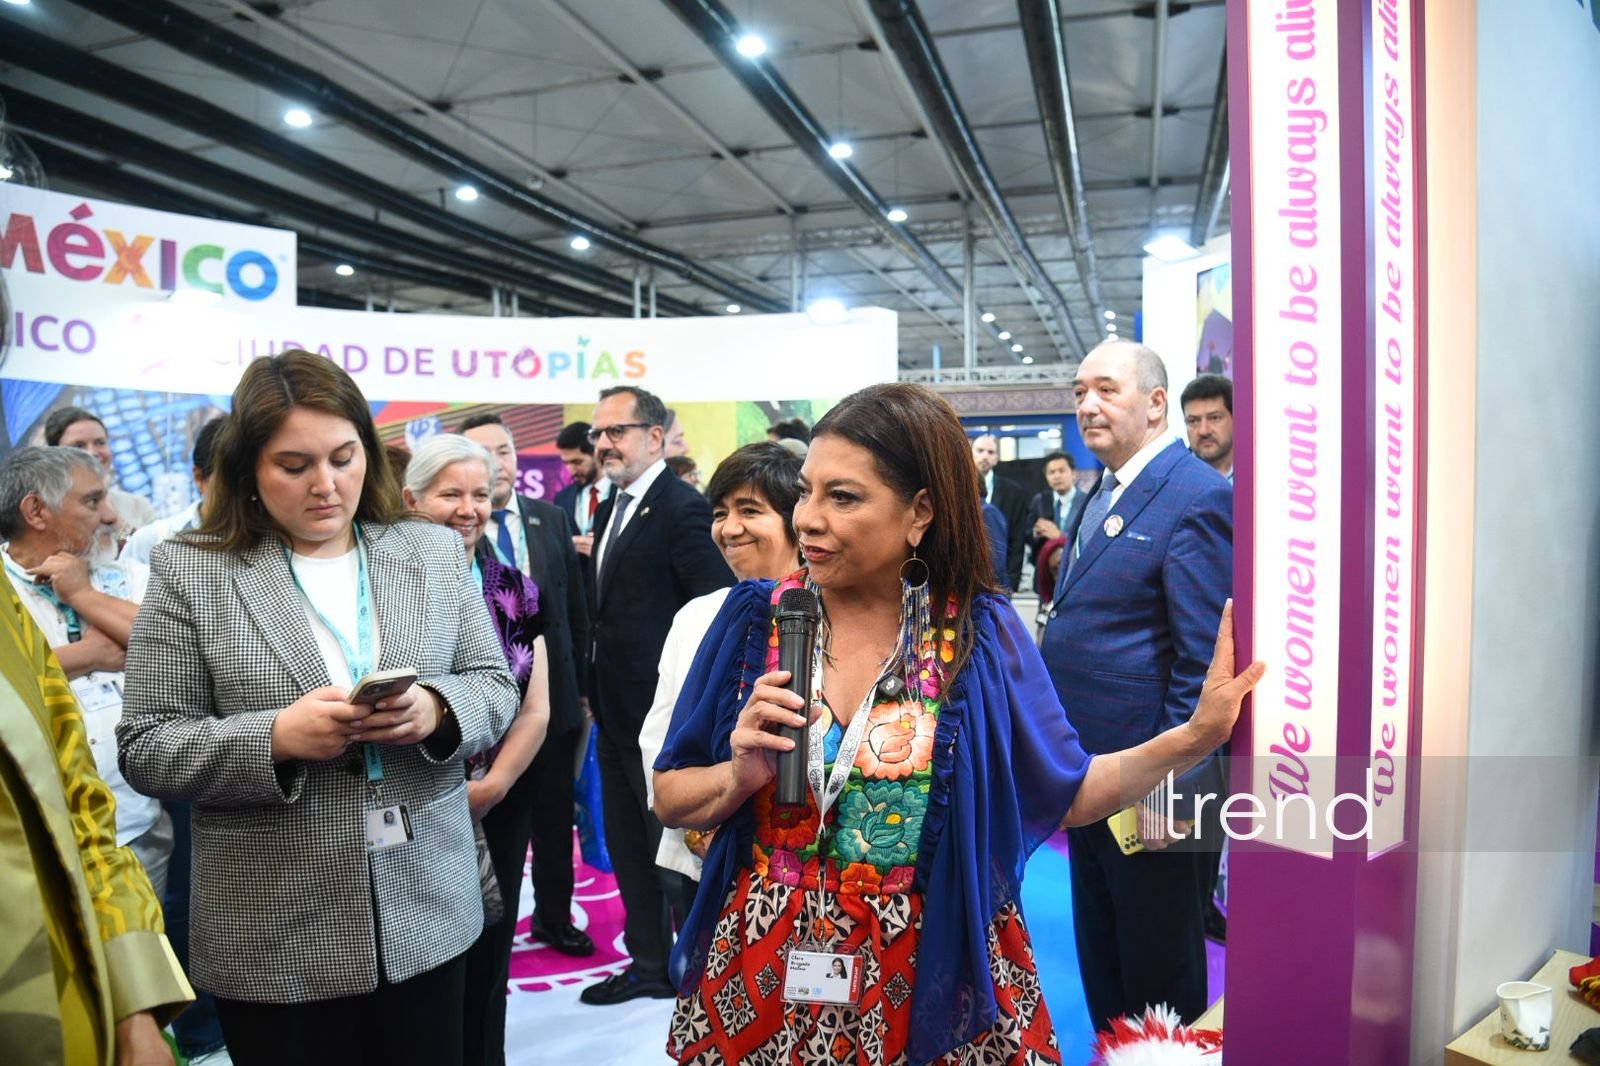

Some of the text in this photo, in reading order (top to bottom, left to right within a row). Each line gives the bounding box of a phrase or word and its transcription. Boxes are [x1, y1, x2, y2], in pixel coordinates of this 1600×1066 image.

[1278, 77, 1328, 249] always
[1380, 72, 1405, 249] always
[1280, 265, 1319, 324] be
[1381, 260, 1402, 323] be
[384, 346, 435, 376] DE
[1284, 340, 1318, 386] to
[1384, 337, 1403, 385] to
[1284, 402, 1318, 522] want
[1384, 402, 1403, 519] want
[1283, 538, 1317, 711] women
[1382, 535, 1401, 708] women
[1269, 722, 1312, 802] We
[1374, 721, 1396, 807] We
